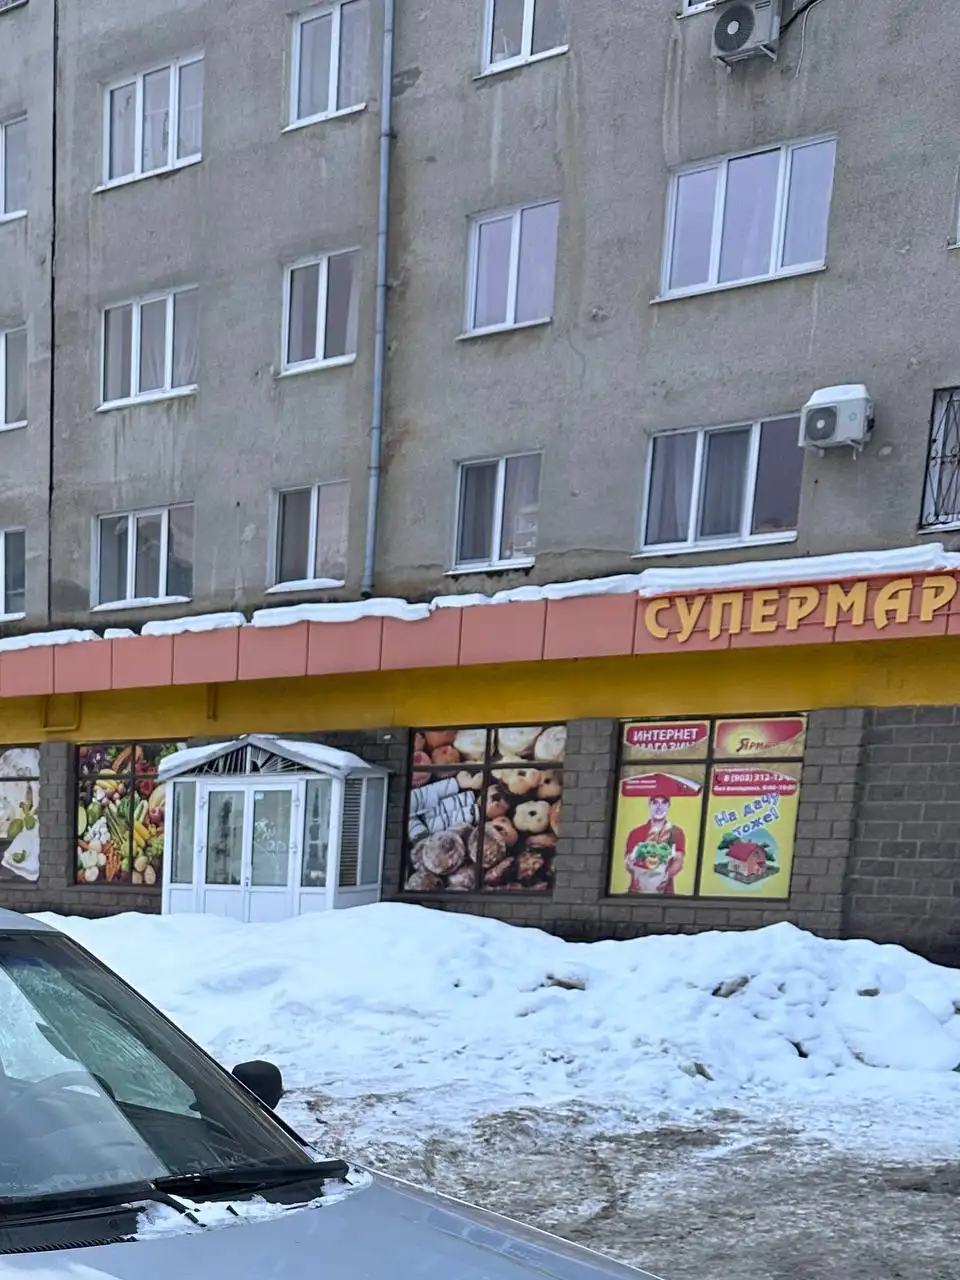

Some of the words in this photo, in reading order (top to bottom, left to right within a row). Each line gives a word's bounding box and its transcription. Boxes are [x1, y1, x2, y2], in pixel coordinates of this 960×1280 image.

[644, 575, 958, 643] СУПЕРМАР
[632, 728, 699, 742] ИНТЕРНЕТ
[714, 810, 737, 827] На
[743, 792, 780, 817] дачу
[731, 806, 780, 837] тоже!
